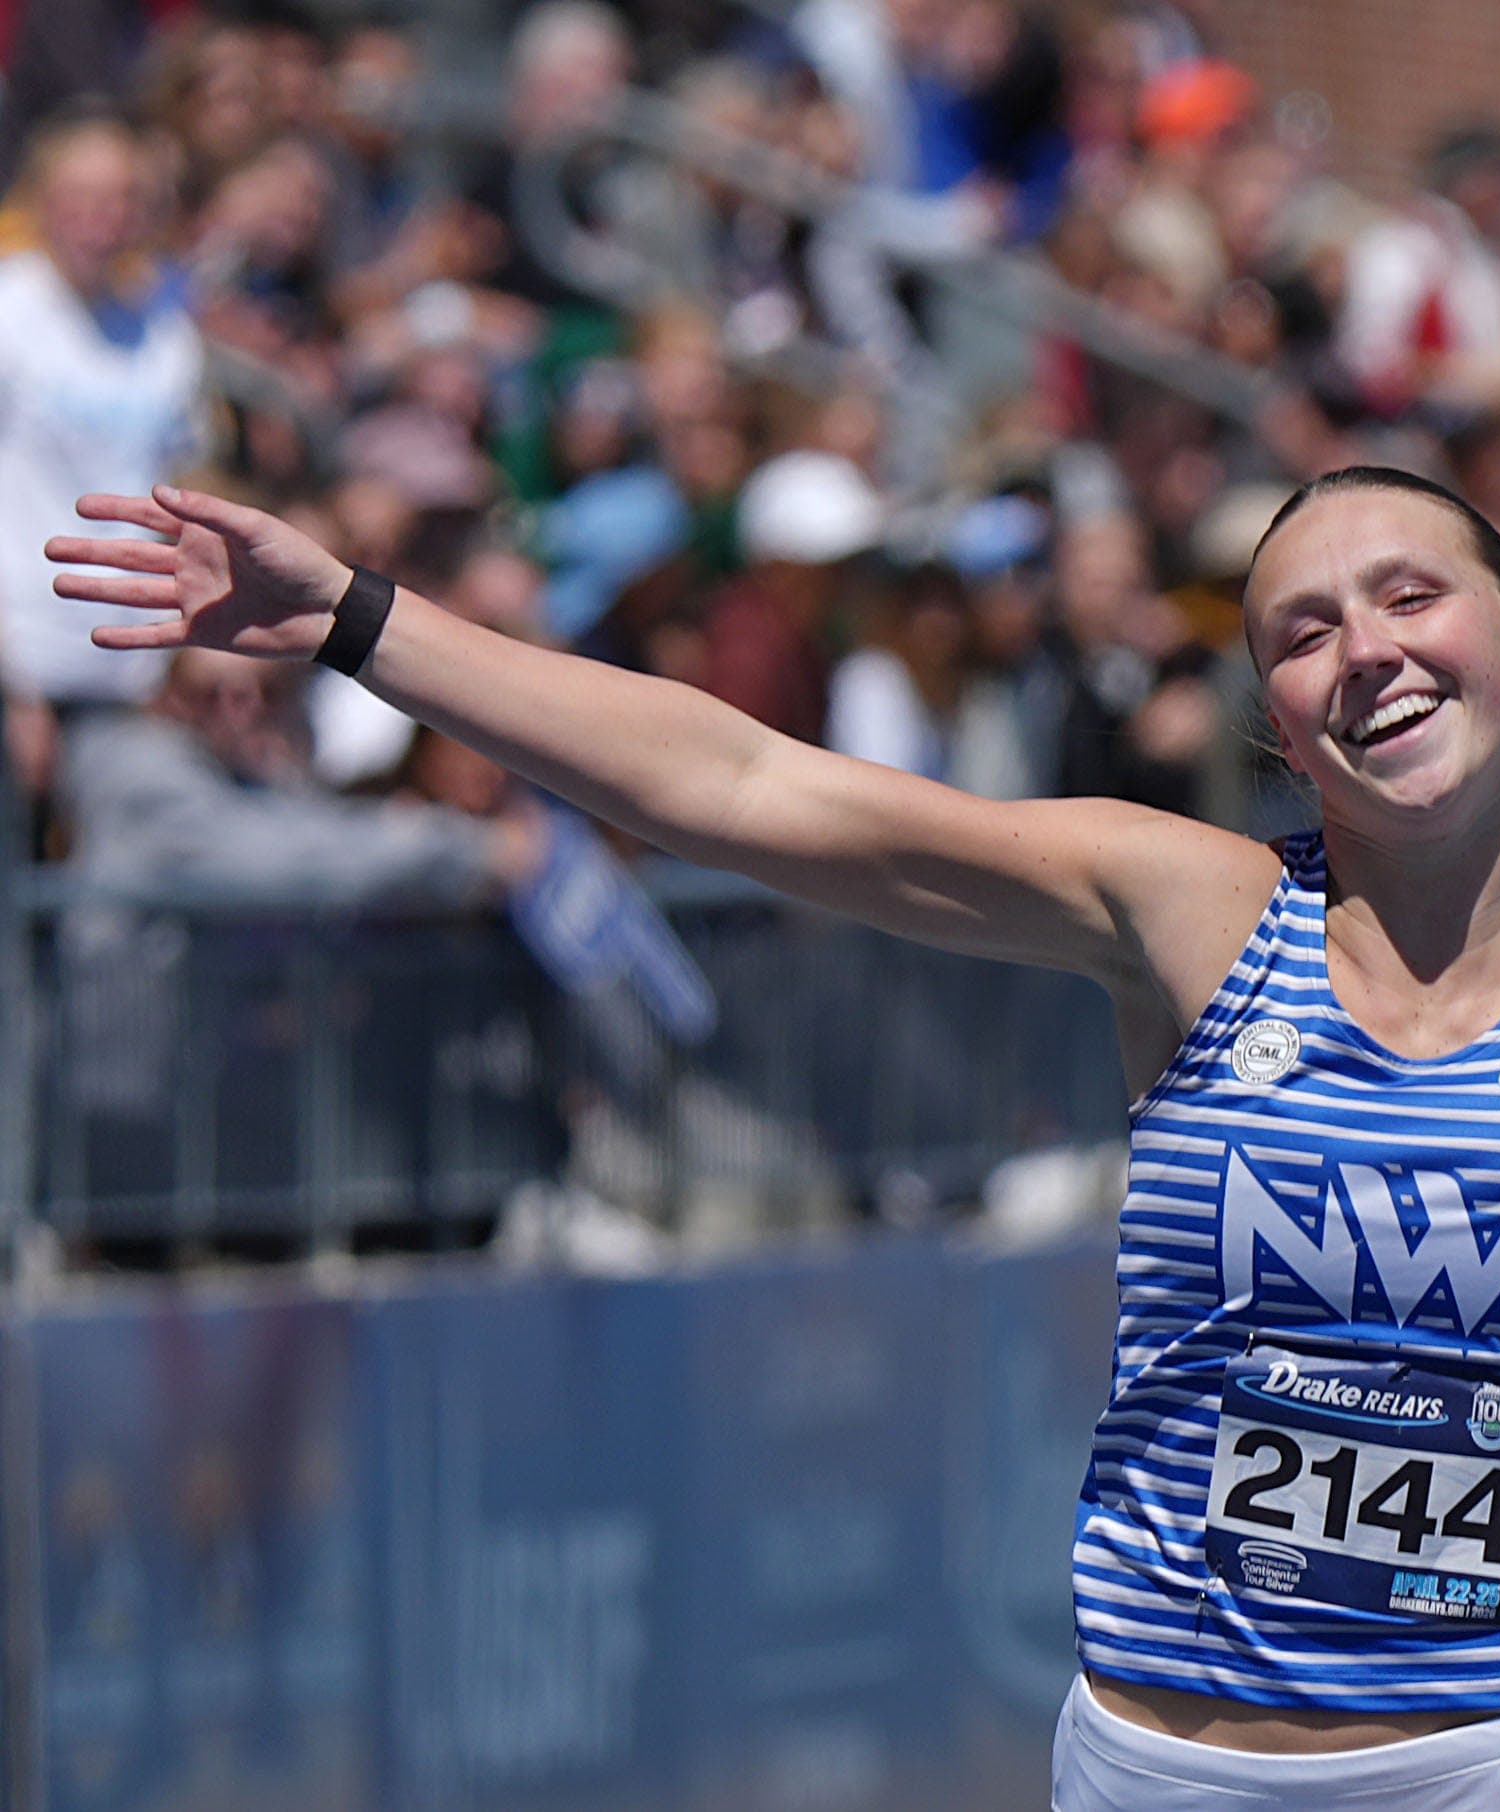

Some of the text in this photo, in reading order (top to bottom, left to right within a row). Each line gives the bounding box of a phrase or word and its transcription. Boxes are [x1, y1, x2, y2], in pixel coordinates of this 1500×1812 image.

[1260, 1361, 1362, 1408] Drake
[1362, 1390, 1443, 1420] RELAYS
[1241, 1560, 1300, 1583] Continental
[1244, 1573, 1295, 1592] Tour Silver
[1391, 1572, 1500, 1608] APRIL 22-25
